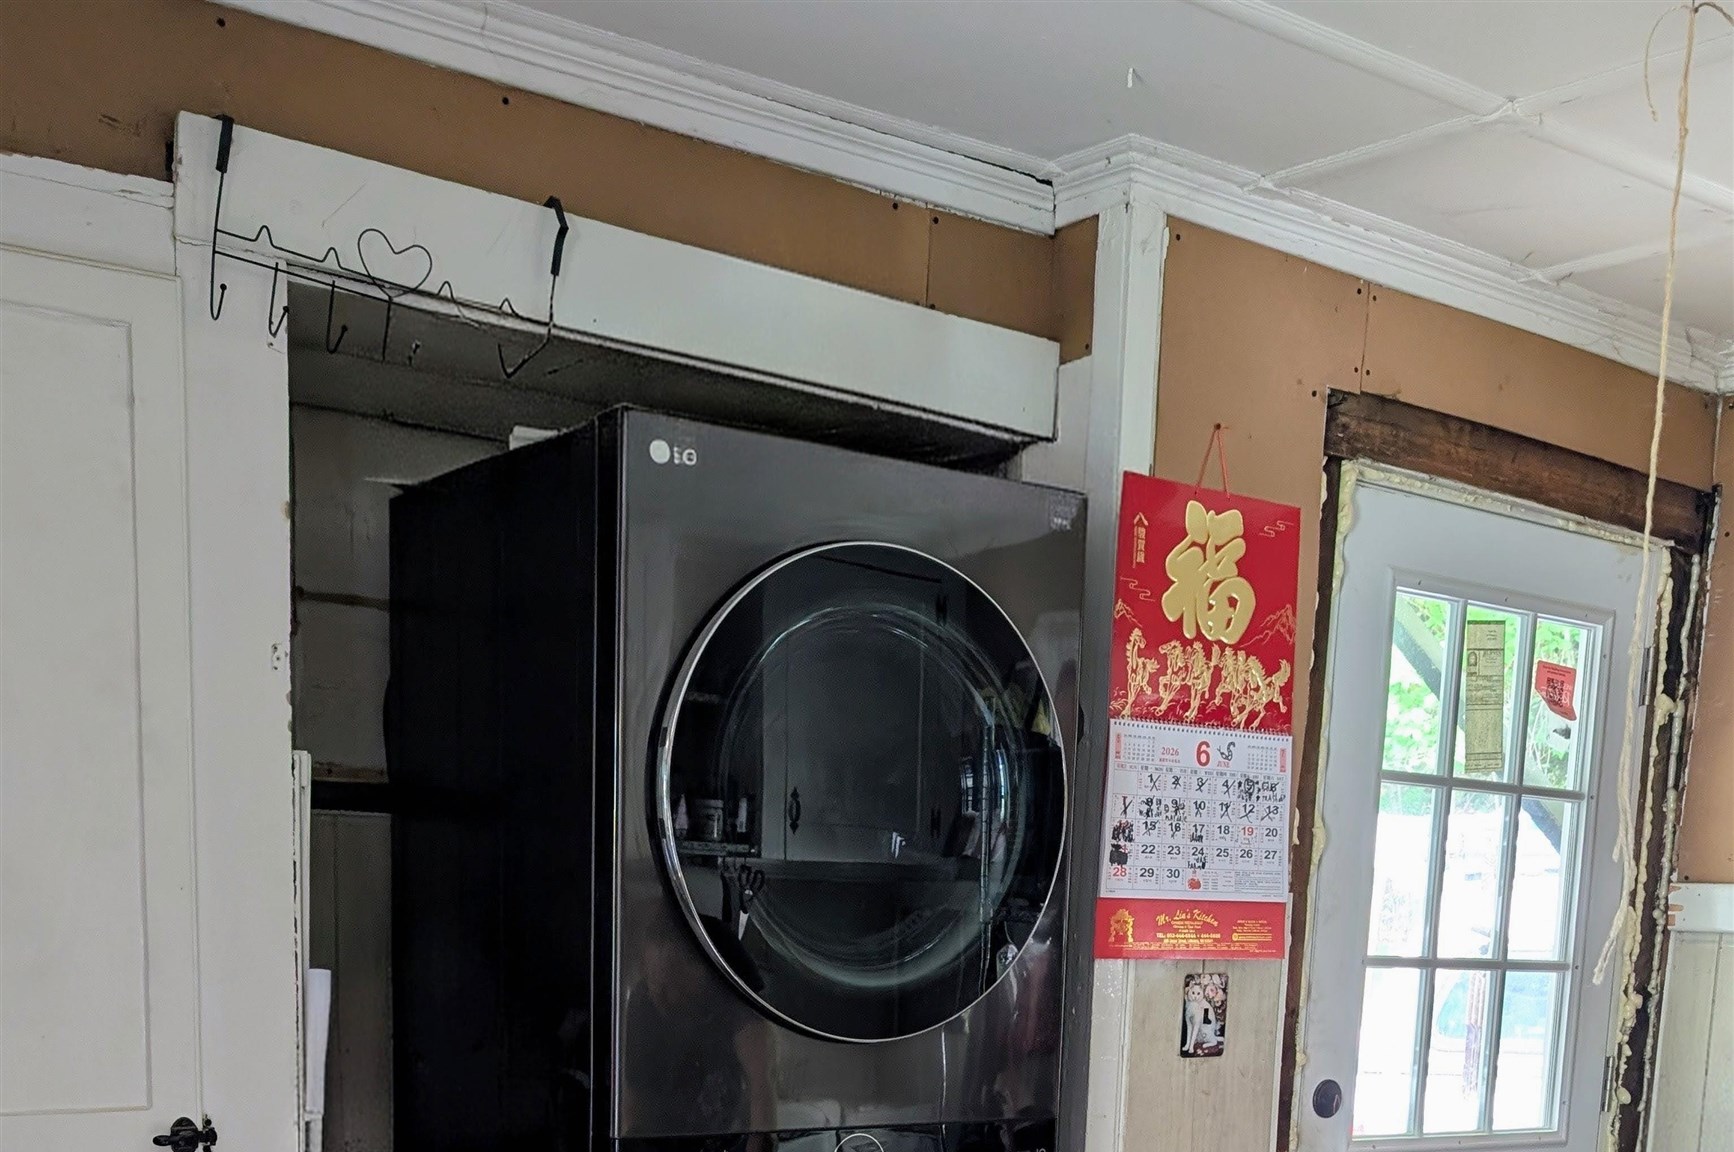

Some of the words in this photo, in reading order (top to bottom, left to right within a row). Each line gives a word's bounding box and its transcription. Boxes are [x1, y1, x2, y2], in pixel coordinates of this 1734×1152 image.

[1161, 500, 1256, 645] 福
[1161, 746, 1180, 756] 2026
[1196, 740, 1211, 767] 6
[1193, 800, 1206, 810] 10
[1242, 804, 1255, 814] 12
[1266, 805, 1279, 815] 13
[1142, 820, 1156, 831] 15
[1192, 823, 1205, 833] 17
[1217, 825, 1230, 835] 18
[1241, 826, 1254, 836] 19
[1265, 828, 1278, 838] 20
[1140, 844, 1156, 854] 22
[1167, 845, 1181, 855] 23
[1191, 846, 1205, 856] 24
[1216, 848, 1229, 857] 25
[1240, 849, 1253, 859] 26
[1264, 850, 1278, 860] 27
[1112, 867, 1127, 877] 28
[1139, 868, 1154, 878] 29
[1166, 868, 1180, 879] 30
[1155, 913, 1171, 926] Mr.
[1192, 909, 1218, 927] Kitchen
